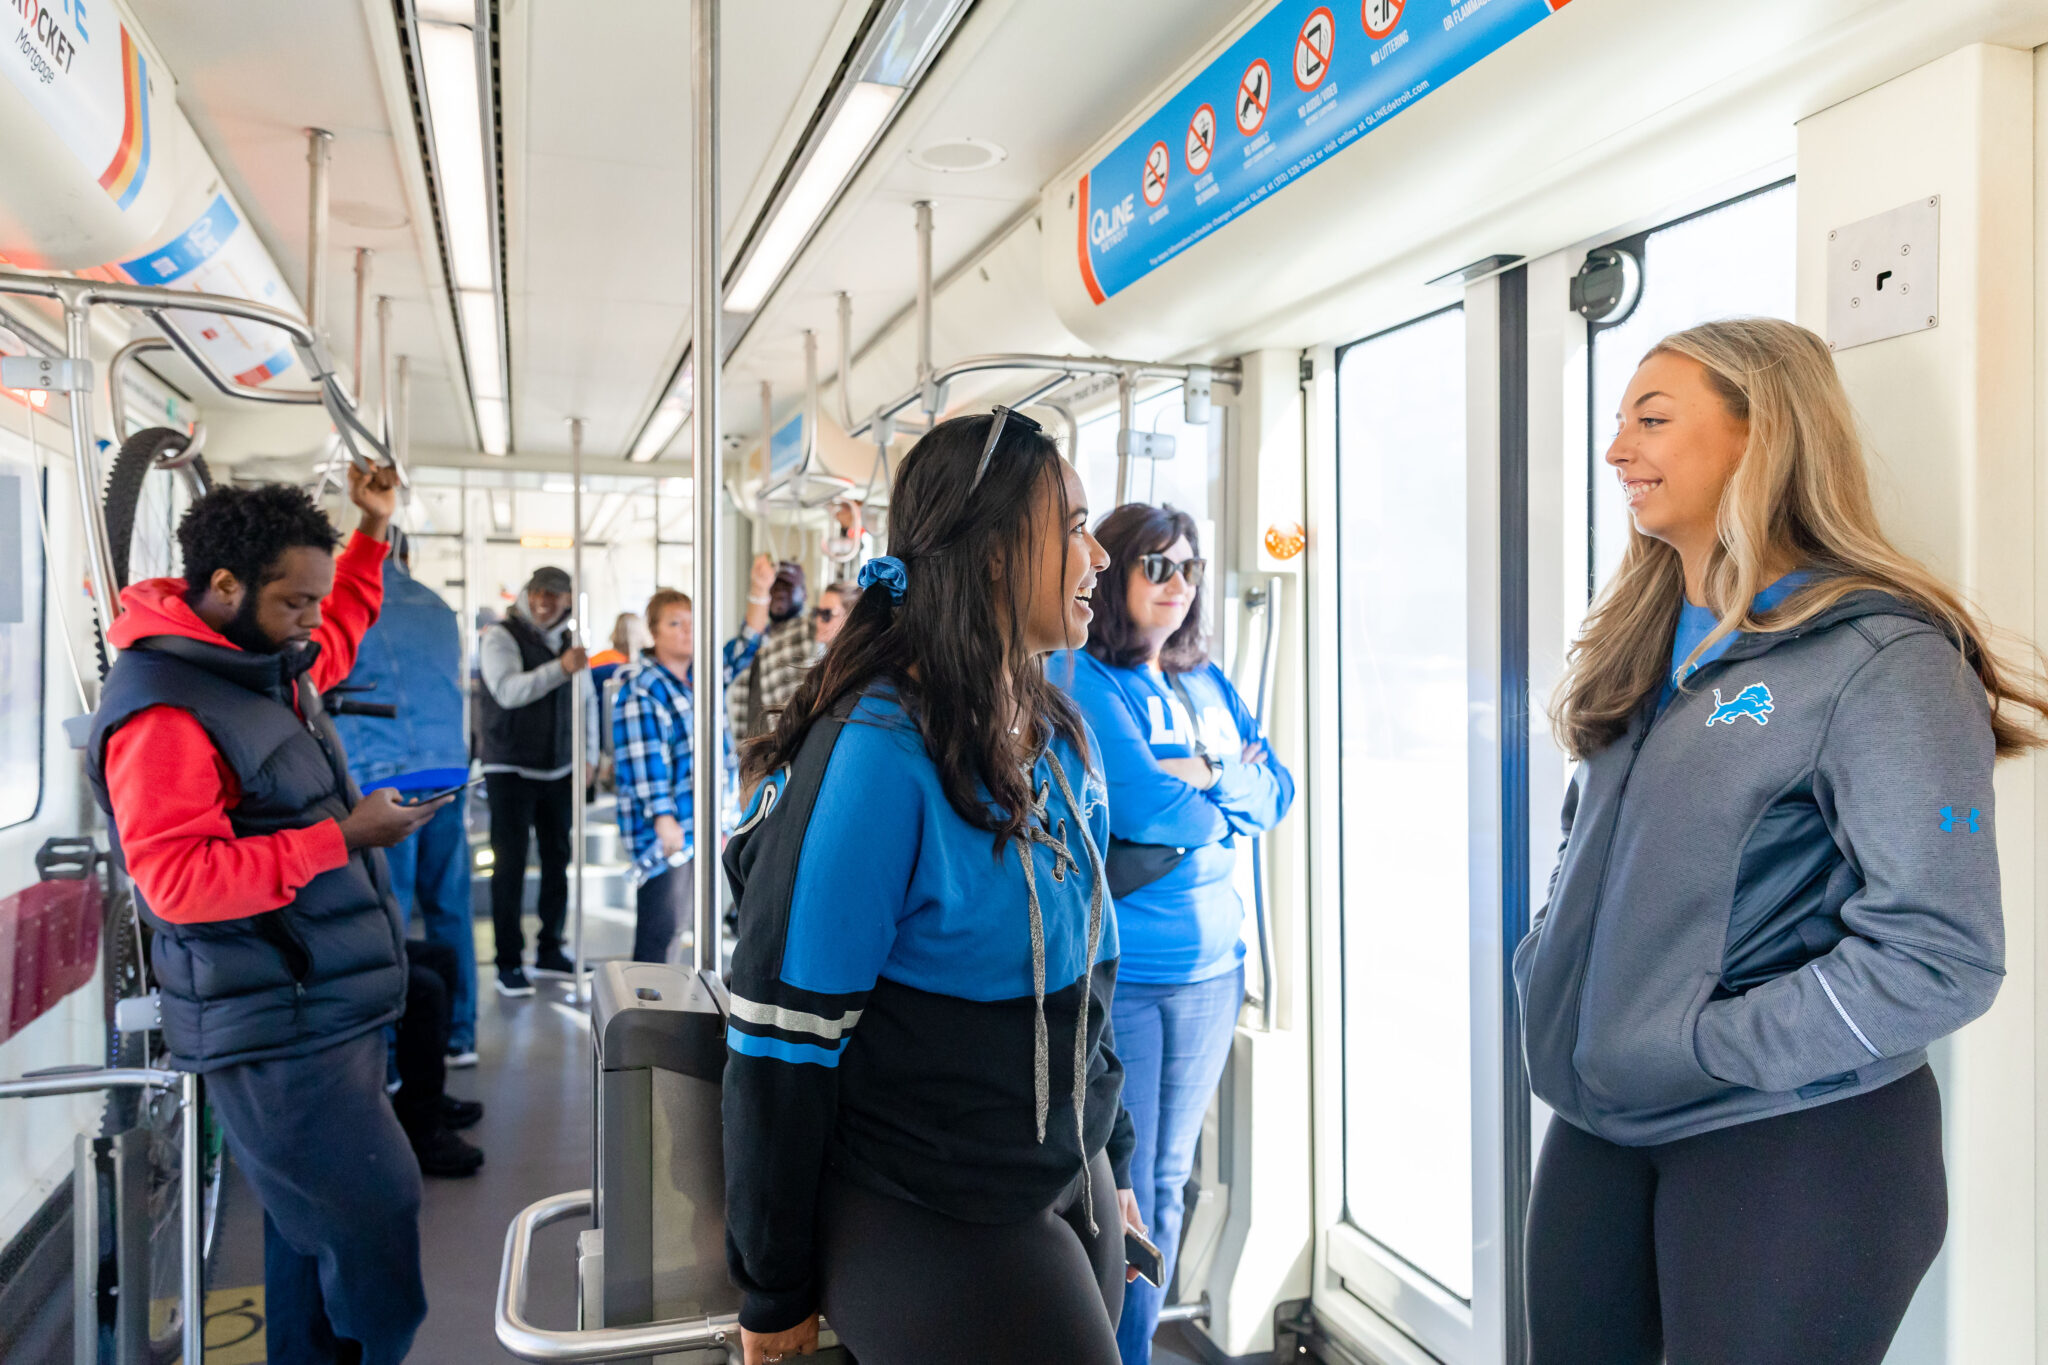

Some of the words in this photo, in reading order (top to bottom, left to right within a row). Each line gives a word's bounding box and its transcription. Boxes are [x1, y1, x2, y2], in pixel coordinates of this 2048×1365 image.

[1370, 50, 1381, 67] NO
[1379, 28, 1409, 61] LITTERING
[1443, 14, 1455, 31] OR
[15, 27, 55, 84] Mortgage
[1323, 139, 1338, 154] visit
[1337, 127, 1359, 145] online
[1357, 120, 1367, 132] at
[1365, 79, 1430, 126] QLINEdetroit.com
[1091, 192, 1135, 246] QLINE
